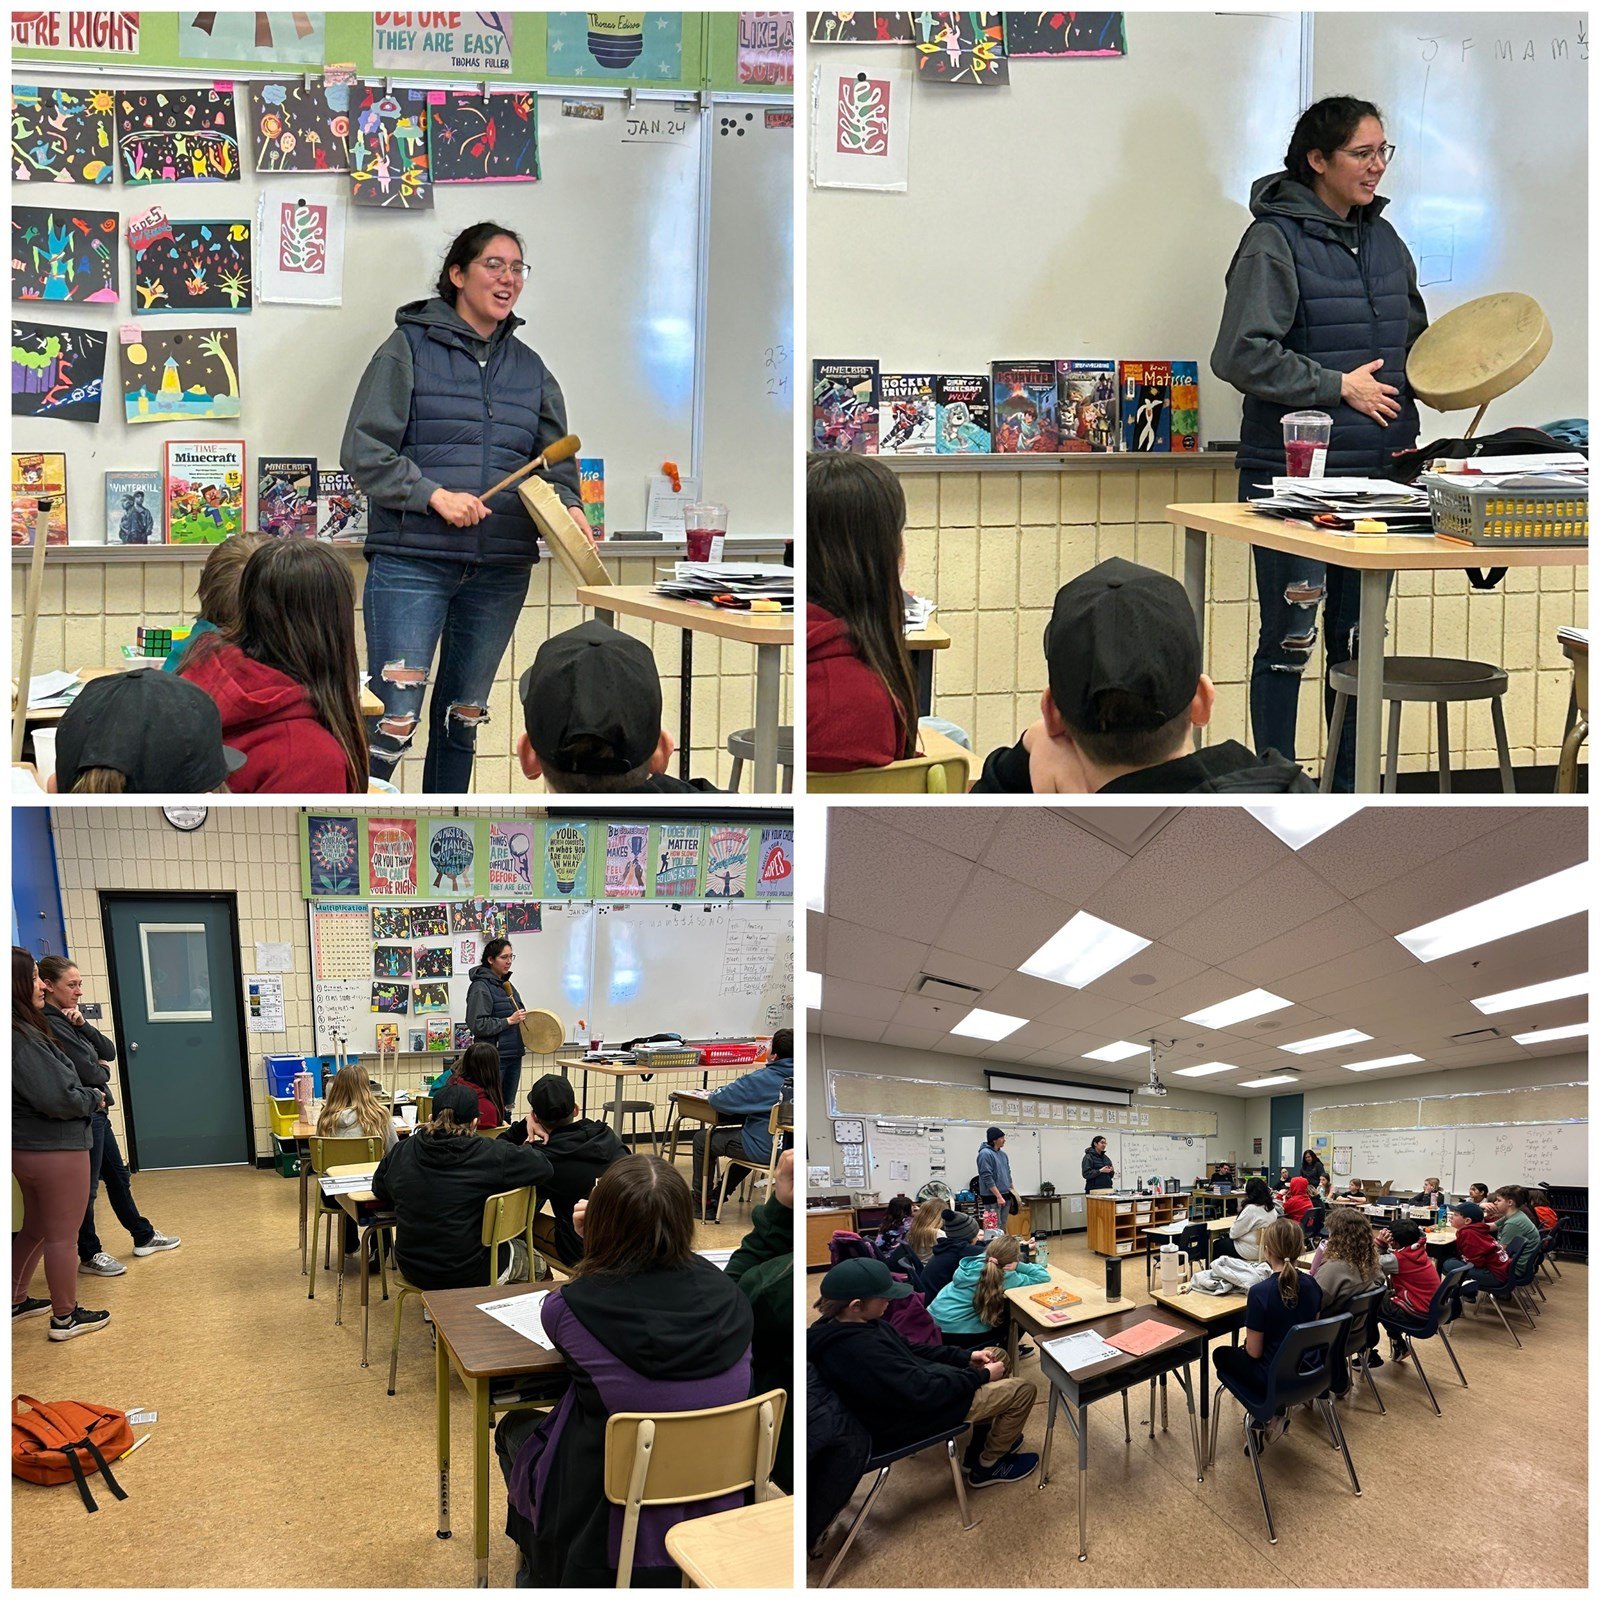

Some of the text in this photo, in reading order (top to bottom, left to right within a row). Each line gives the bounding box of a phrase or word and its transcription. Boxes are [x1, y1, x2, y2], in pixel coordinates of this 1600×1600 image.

[68, 11, 137, 51] RIGHT
[739, 20, 778, 48] LIKE
[376, 30, 503, 55] THEY ARE EASY
[451, 56, 509, 69] THOMAS FULLER
[667, 121, 685, 135] 24
[820, 366, 874, 374] MINECRAFT
[882, 377, 932, 389] HOCKEY
[1144, 371, 1193, 386] Matisse
[882, 386, 920, 397] TRIVIA
[194, 444, 217, 453] TIME
[175, 453, 236, 463] Minecraft
[264, 463, 312, 471] MINECRAFT
[228, 472, 239, 480] 15
[319, 474, 352, 483] HOCK
[580, 467, 600, 481] isse
[109, 483, 159, 493] WINTERKILL
[319, 483, 353, 491] TRIVIA
[490, 824, 500, 835] ALL
[556, 828, 578, 839] YOUR
[490, 835, 507, 846] THINGS
[667, 839, 698, 850] MATTER
[431, 840, 473, 857] CHANGE
[490, 847, 508, 860] ARE
[607, 846, 628, 857] MAKES
[374, 853, 382, 866] OR
[383, 854, 393, 868] YOU
[490, 870, 517, 883] BEFORE
[395, 880, 416, 894] RIGHT
